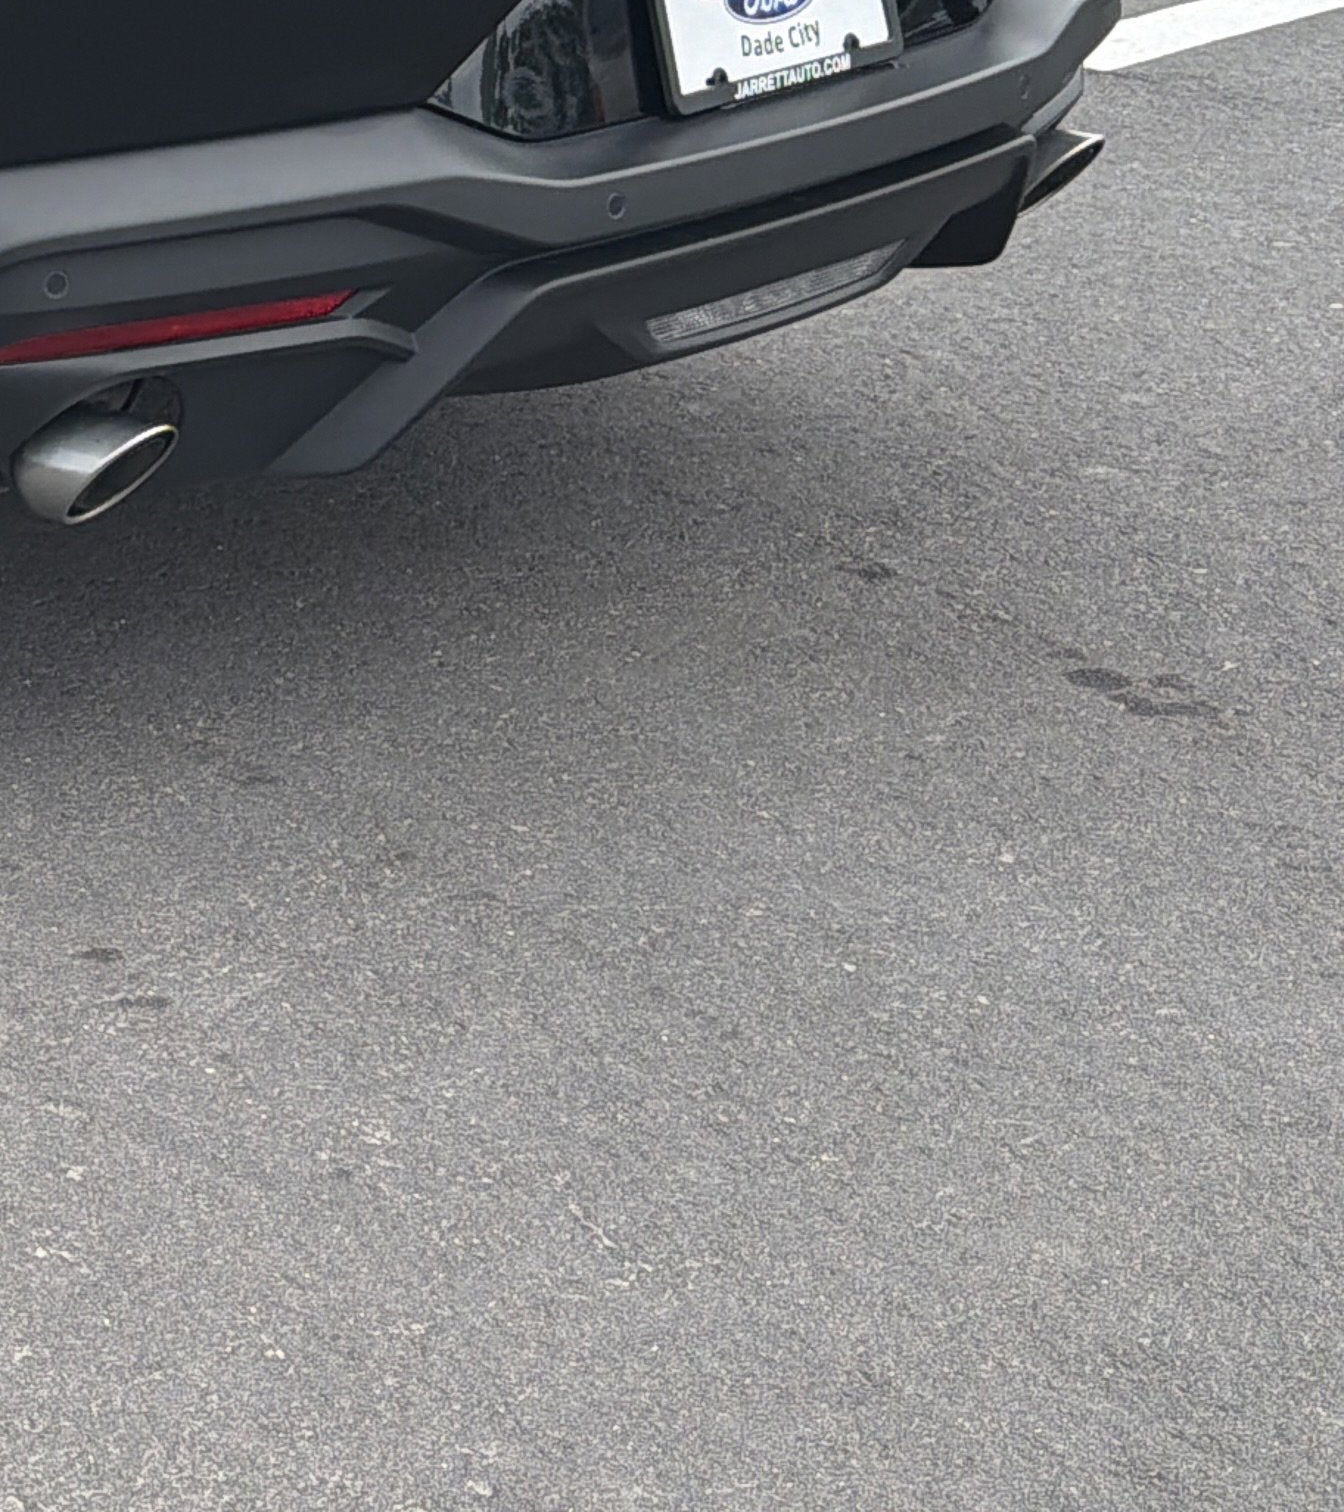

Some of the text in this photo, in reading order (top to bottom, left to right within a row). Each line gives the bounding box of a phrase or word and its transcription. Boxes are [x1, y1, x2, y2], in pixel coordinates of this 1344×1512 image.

[740, 20, 821, 57] Dade City
[734, 52, 852, 100] JARRETTAUTO.COM
